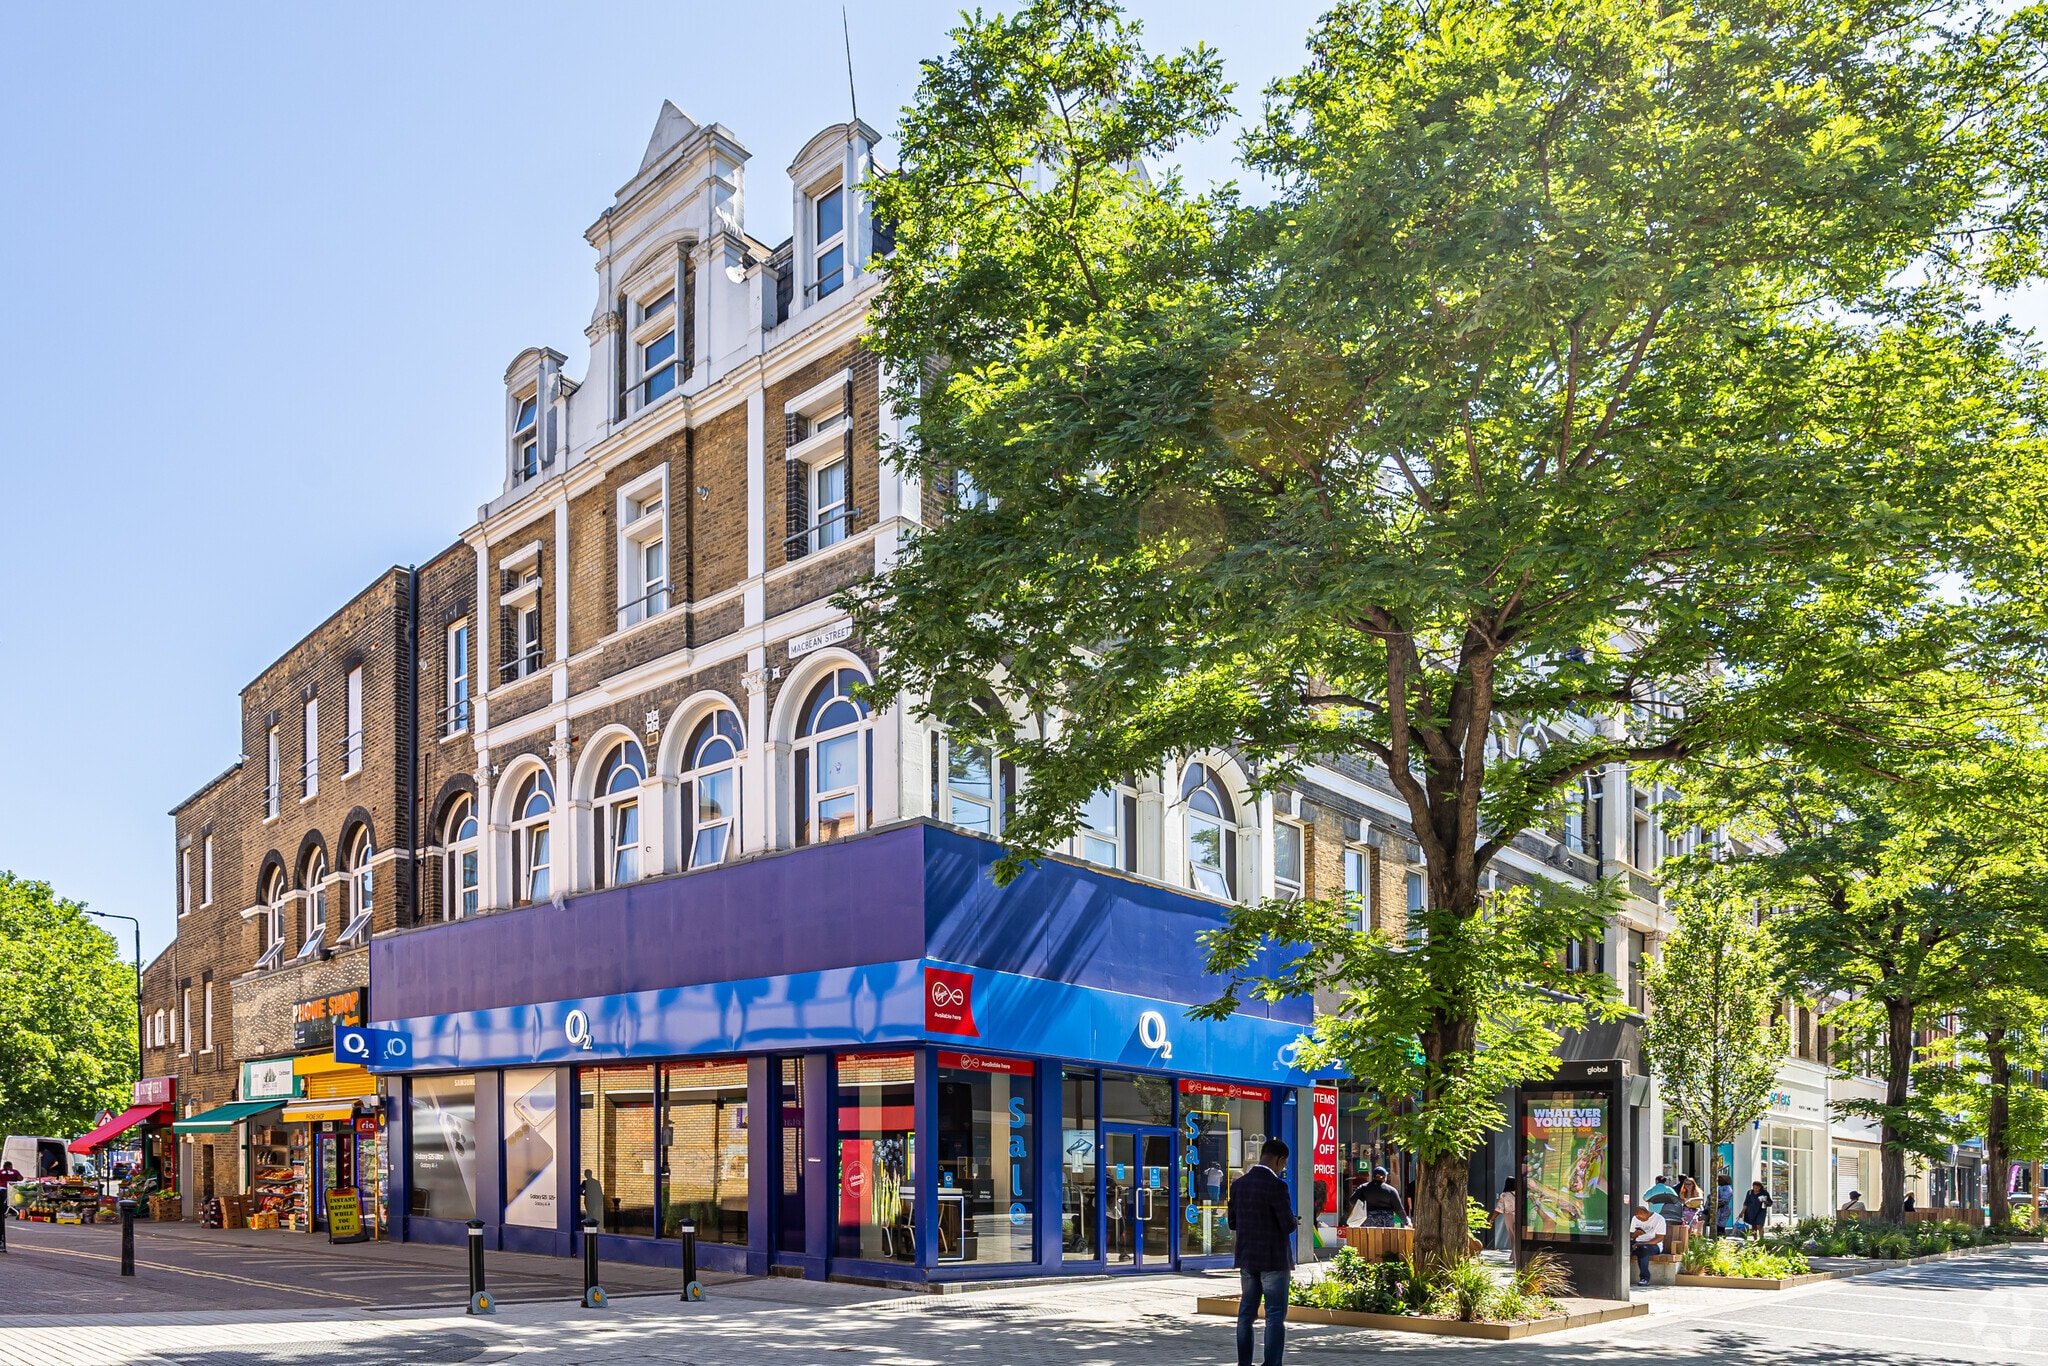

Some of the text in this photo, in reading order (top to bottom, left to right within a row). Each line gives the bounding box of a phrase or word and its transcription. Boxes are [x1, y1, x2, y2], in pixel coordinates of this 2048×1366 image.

[790, 627, 849, 653] MACBEAN STREET
[293, 991, 358, 1023] PHONE SHOP
[1587, 1066, 1608, 1075] global
[1314, 1093, 1335, 1105] ITEMS
[1534, 1108, 1601, 1118] WHATEVER
[361, 1121, 374, 1129] ria
[1534, 1117, 1601, 1127] YOUR SUB
[1319, 1143, 1335, 1155] OFF
[1008, 1097, 1027, 1225] Sale
[1185, 1112, 1200, 1224] Sale
[1314, 1164, 1335, 1175] PRICE
